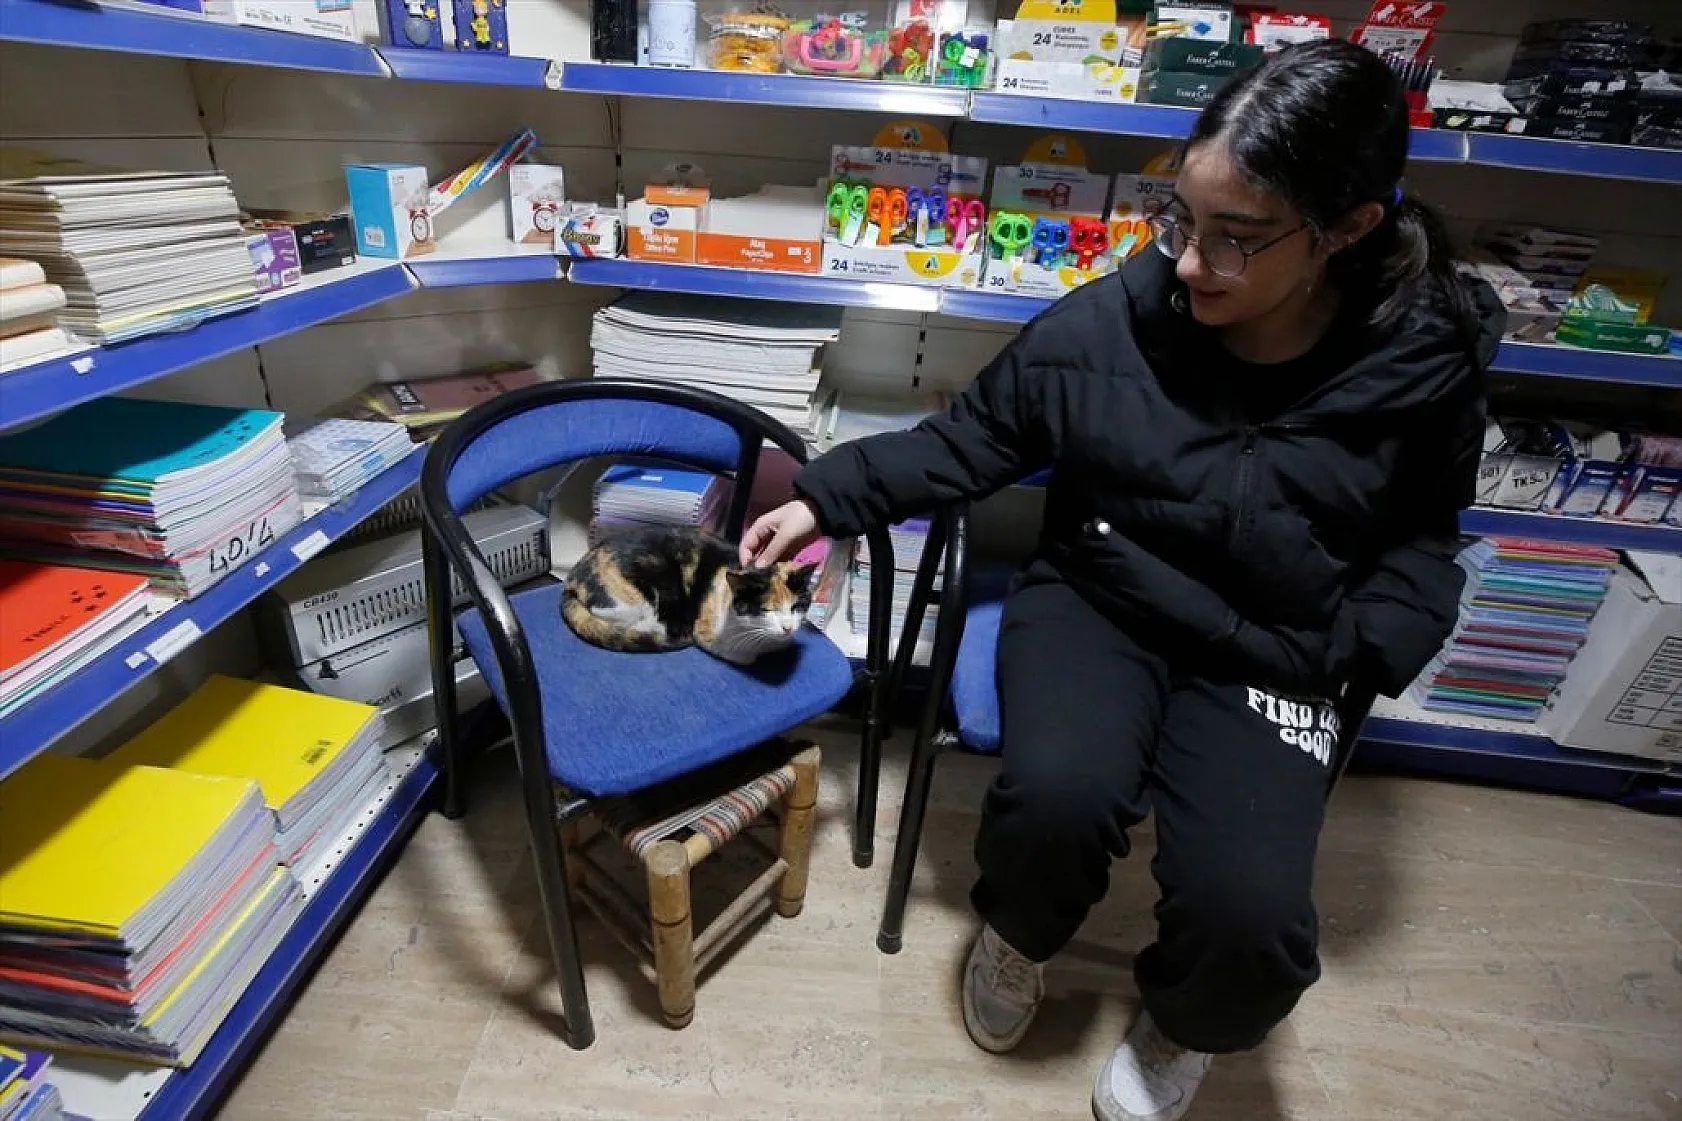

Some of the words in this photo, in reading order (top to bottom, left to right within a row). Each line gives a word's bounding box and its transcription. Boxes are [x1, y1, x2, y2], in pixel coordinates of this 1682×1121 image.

[1033, 33, 1052, 45] 24
[1003, 78, 1018, 88] 24
[876, 151, 892, 163] 24
[1019, 167, 1034, 178] 30
[831, 259, 848, 271] 24
[990, 275, 1005, 287] 30
[1246, 686, 1312, 728] FIND
[1279, 727, 1331, 766] GOOD
